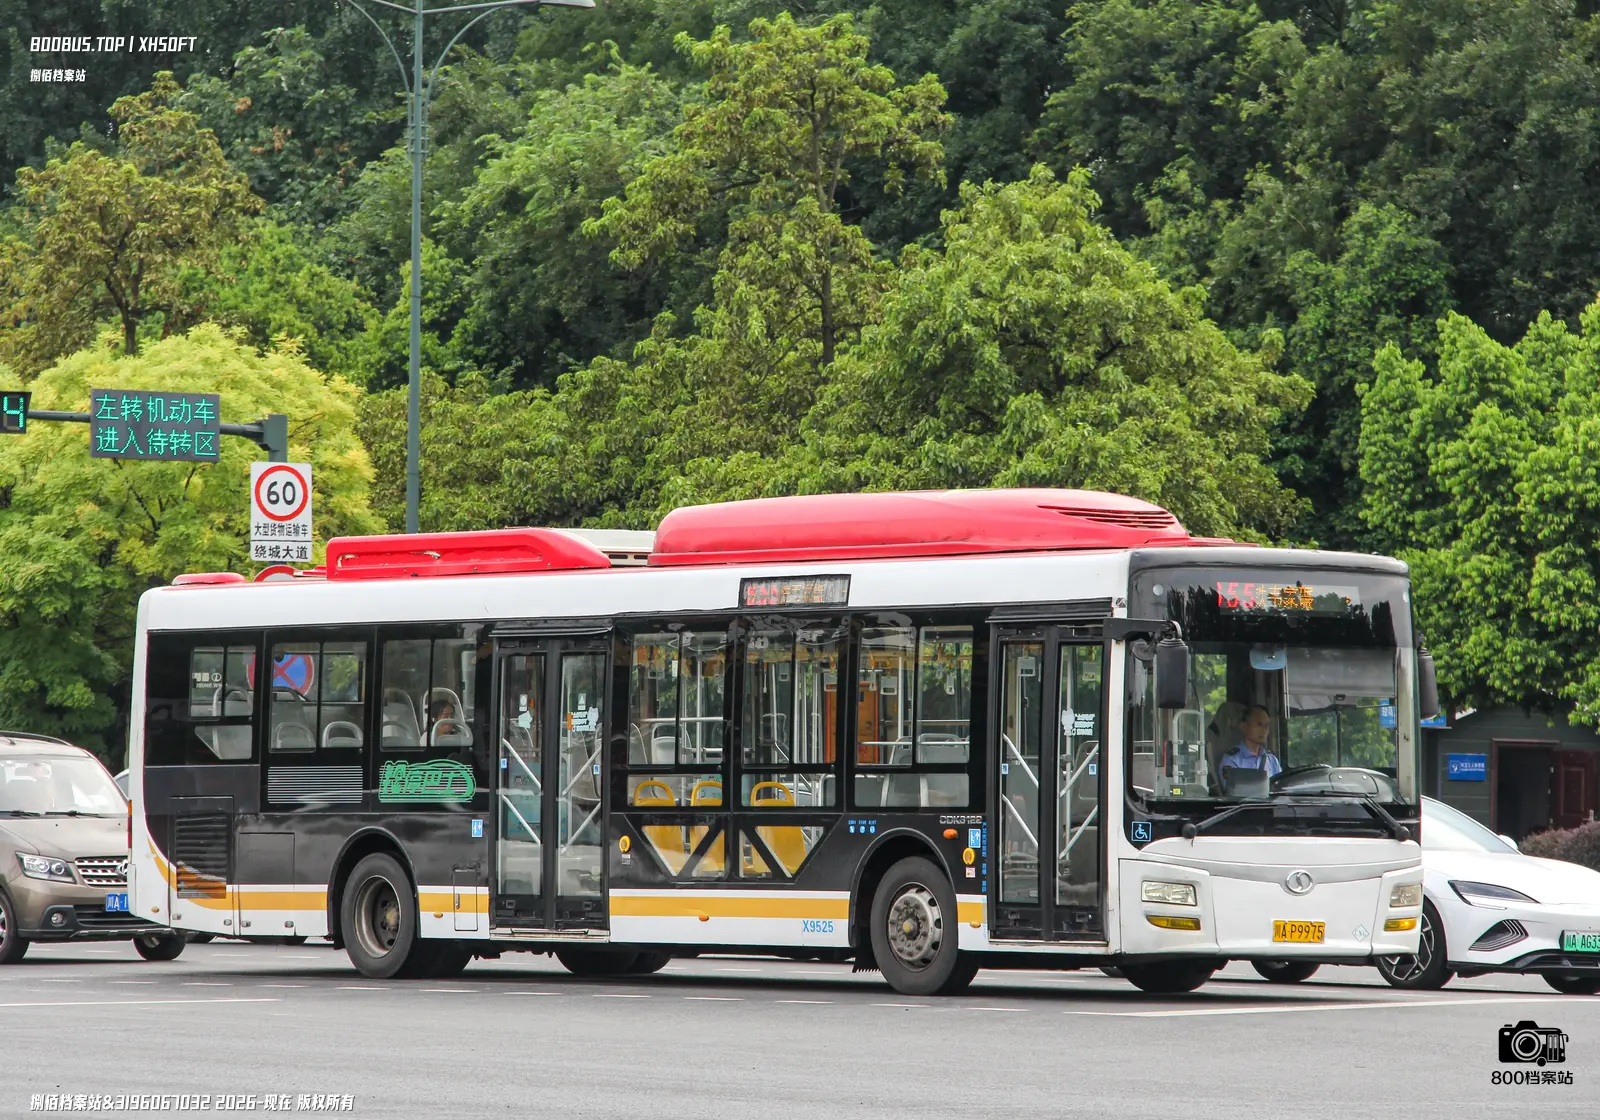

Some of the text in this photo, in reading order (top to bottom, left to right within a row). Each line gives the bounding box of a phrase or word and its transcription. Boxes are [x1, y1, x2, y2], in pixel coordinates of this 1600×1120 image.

[3, 395, 24, 428] 4
[95, 393, 216, 425] 左转机动车
[95, 426, 217, 456] 进入待转区
[266, 480, 296, 506] 60
[254, 521, 309, 538] 大型货物运输车
[254, 544, 309, 560] 绕城大道
[802, 919, 834, 933] X9525
